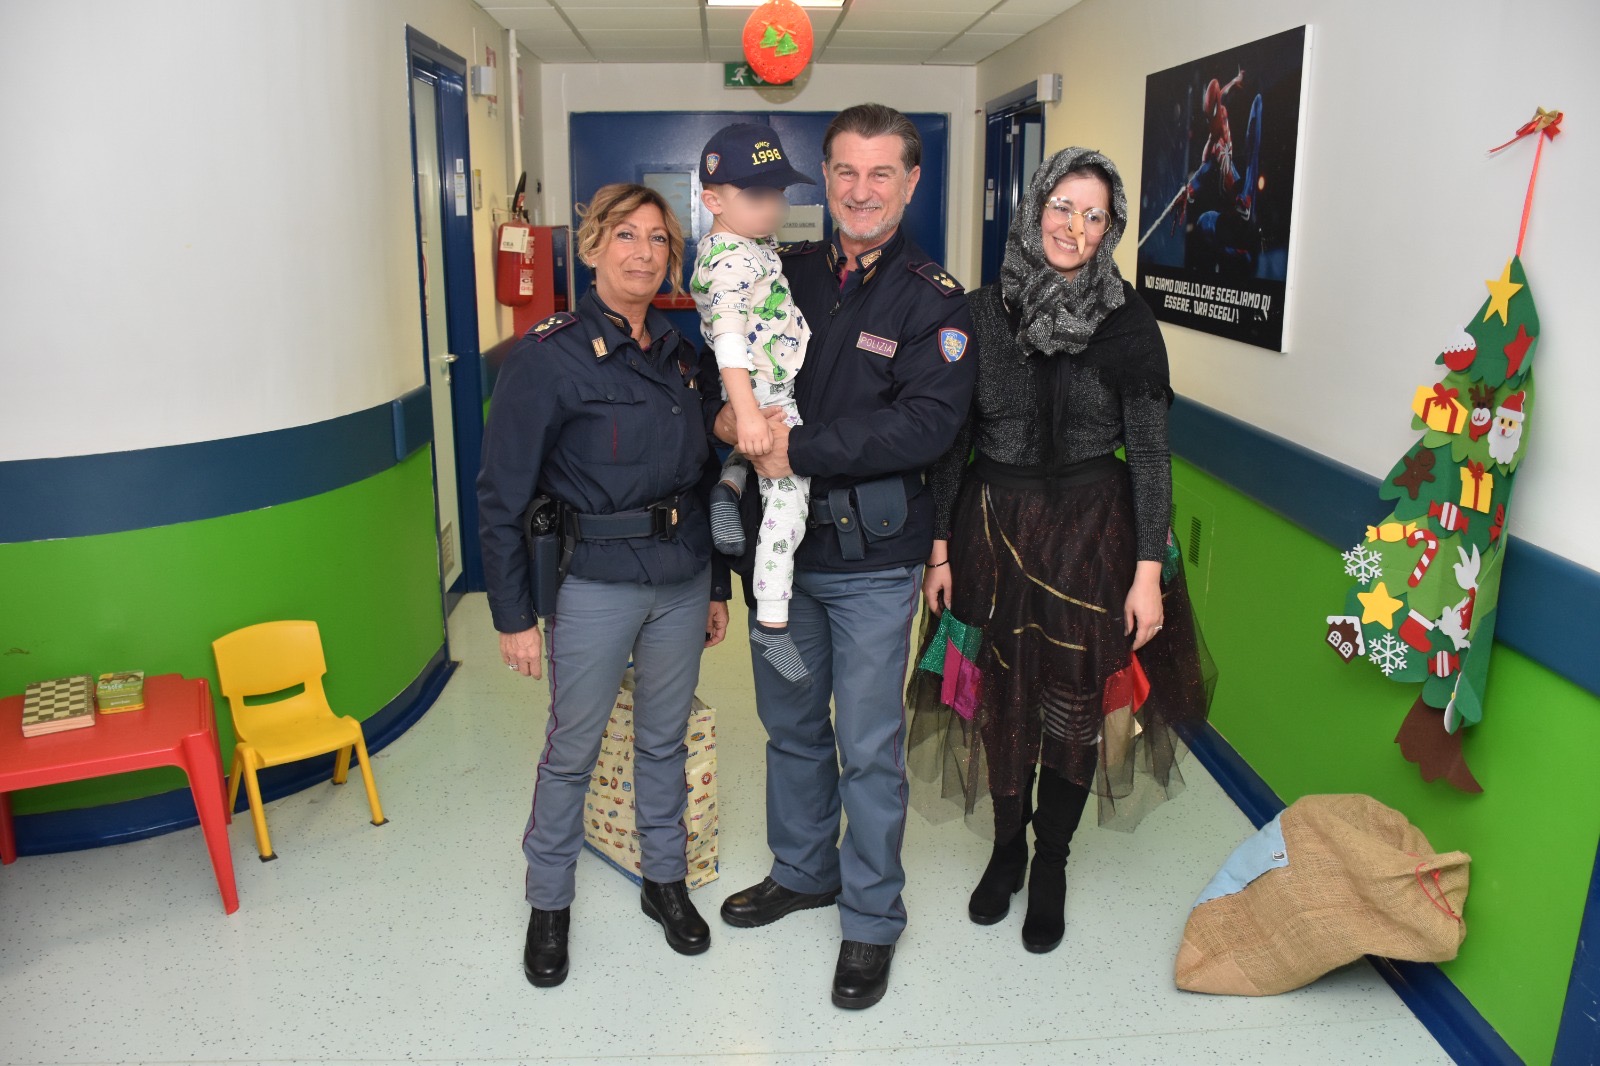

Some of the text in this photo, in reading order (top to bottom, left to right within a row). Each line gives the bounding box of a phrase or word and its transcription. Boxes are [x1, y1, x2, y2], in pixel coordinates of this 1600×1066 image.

[752, 148, 782, 165] 1998
[1145, 275, 1155, 289] NOI
[1155, 277, 1174, 293] SIAMO
[1174, 280, 1200, 298] QUELLO
[1200, 284, 1216, 301] CHE
[1215, 287, 1261, 309] SCEGLIAMO
[1193, 300, 1208, 317] ORA
[861, 336, 892, 353] POLIZIA
